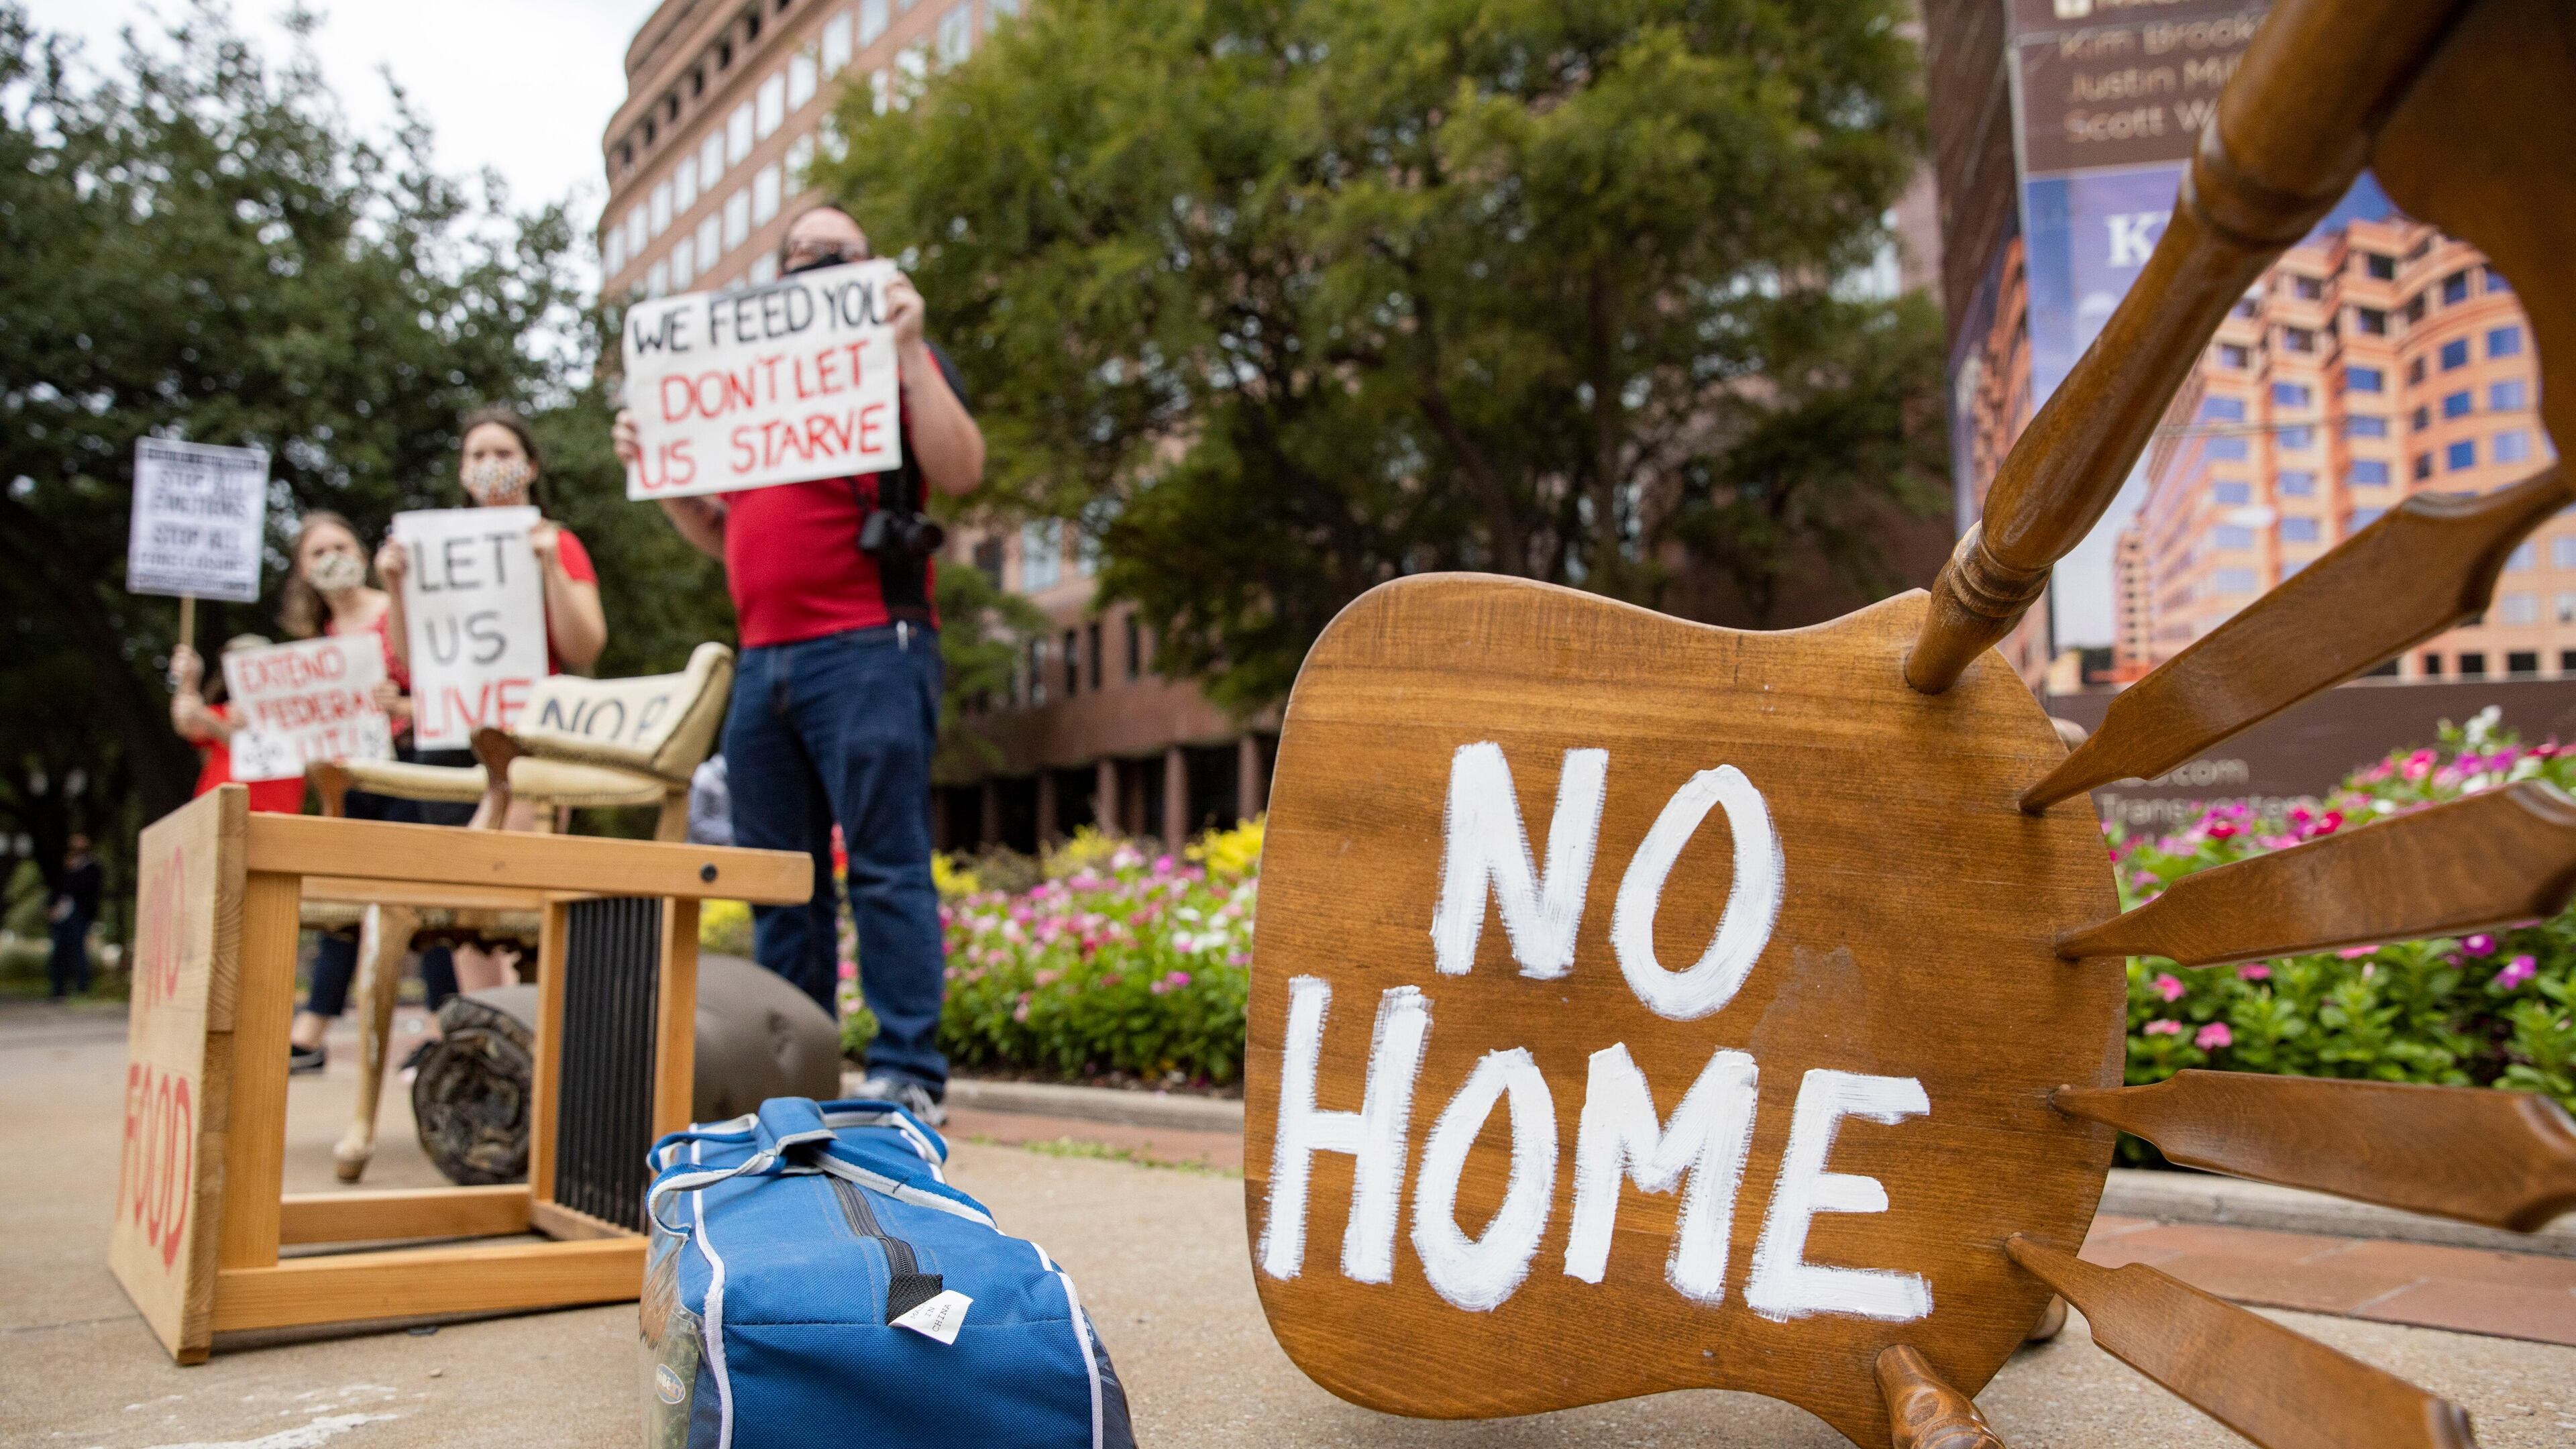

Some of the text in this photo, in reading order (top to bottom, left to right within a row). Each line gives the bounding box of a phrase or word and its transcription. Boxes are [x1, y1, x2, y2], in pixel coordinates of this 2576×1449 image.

[2063, 107, 2164, 144] Scott
[633, 306, 693, 354] WE
[709, 283, 814, 345] FEED
[794, 339, 871, 400] LET
[637, 402, 886, 490] US STARVE
[412, 531, 521, 593] LET
[425, 611, 508, 667] US
[415, 678, 531, 738] LIVE
[539, 696, 627, 742] NO
[1430, 739, 1785, 1021] NO
[144, 844, 186, 1013] NO
[115, 1063, 193, 1276] FOOD
[1257, 974, 1935, 1323] HOME
[932, 1303, 952, 1332] CHINA
